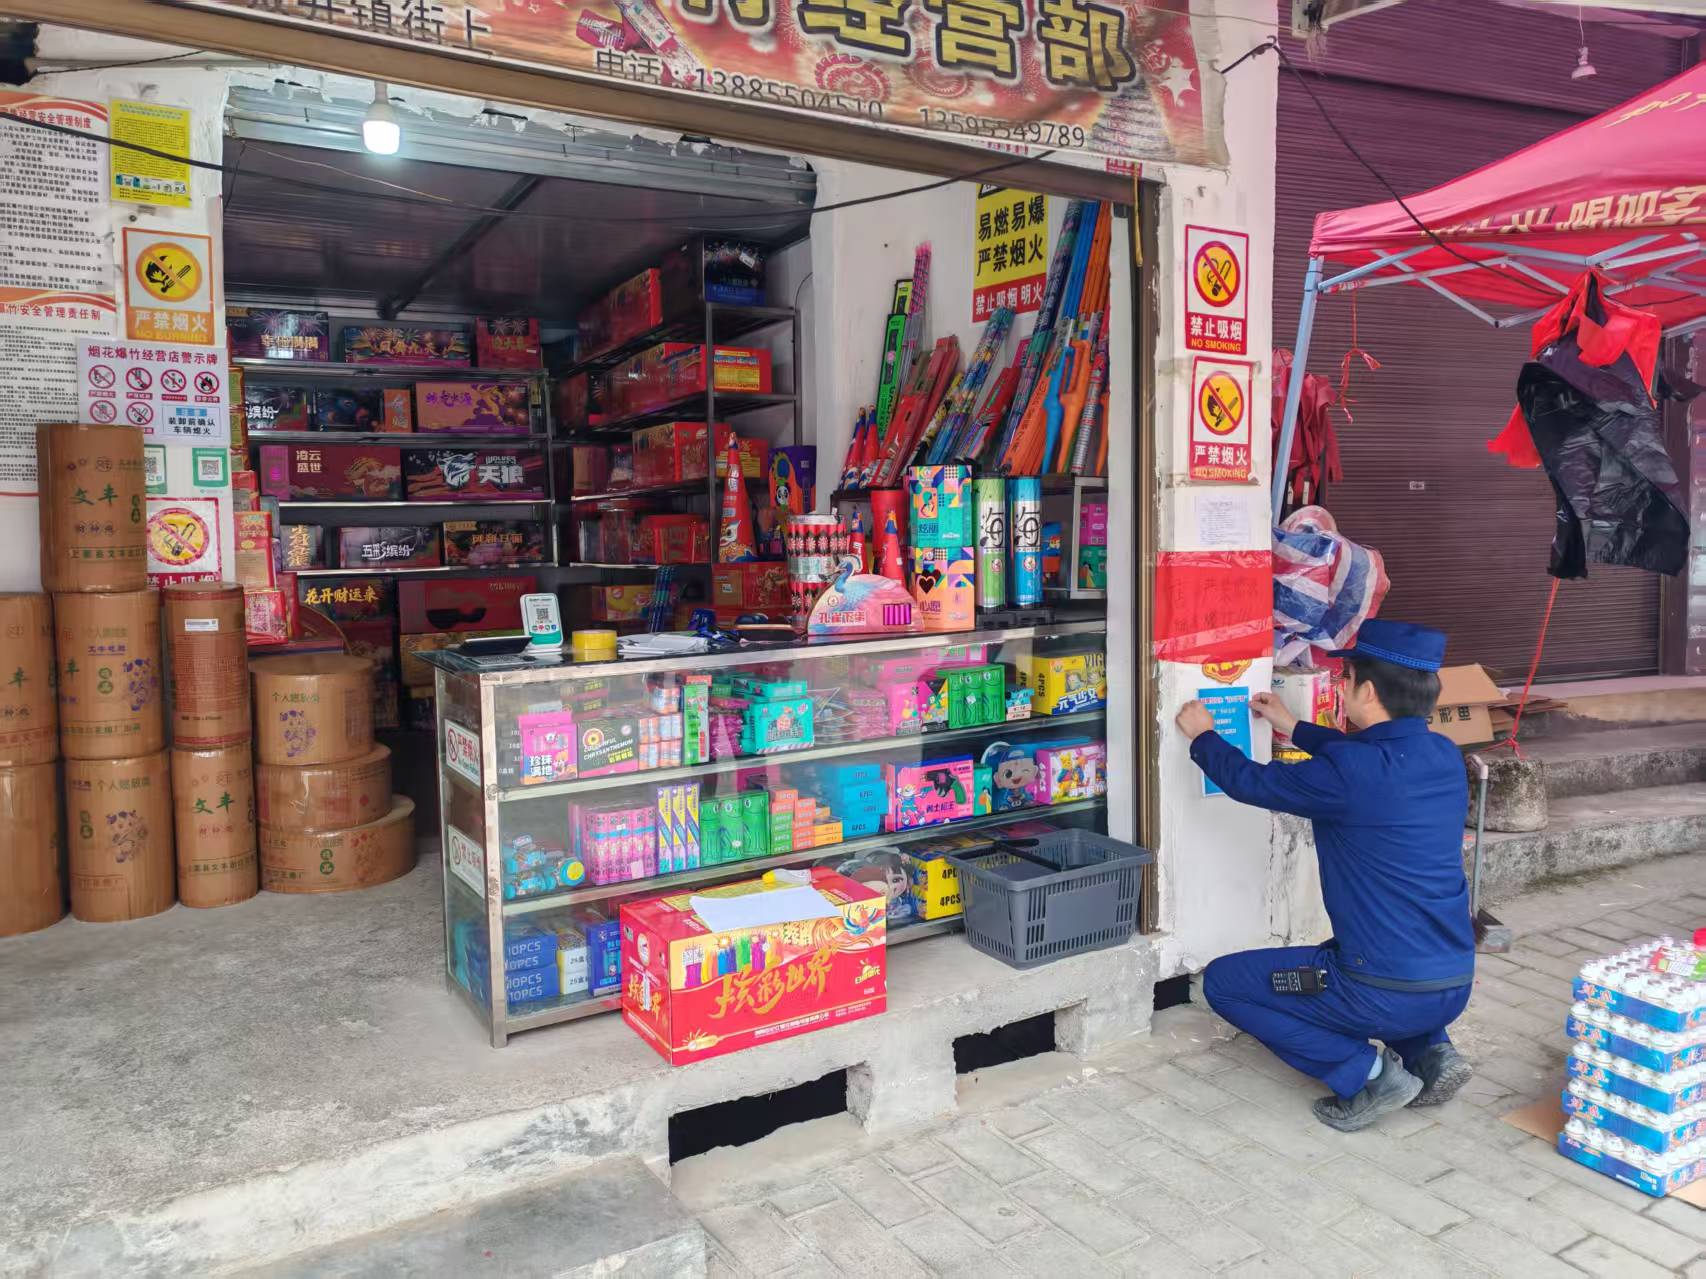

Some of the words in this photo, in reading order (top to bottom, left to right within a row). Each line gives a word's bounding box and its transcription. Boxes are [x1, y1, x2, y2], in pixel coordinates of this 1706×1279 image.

[978, 194, 1046, 243] 易燃易爆
[976, 233, 1045, 277] 严禁烟火
[135, 310, 208, 333] 严禁烟火
[1190, 315, 1242, 341] 禁止吸烟
[88, 344, 218, 365] 烟花爆竹经营店警示牌
[1190, 338, 1203, 348] NO
[1204, 341, 1242, 353] SMOKING
[1193, 444, 1248, 467] 严禁烟火
[361, 541, 416, 562] 五彩缤纷
[304, 584, 379, 605] 花开财运来
[529, 754, 553, 766] 珍珠
[530, 764, 553, 777] 满地
[939, 894, 961, 907] 4PCS
